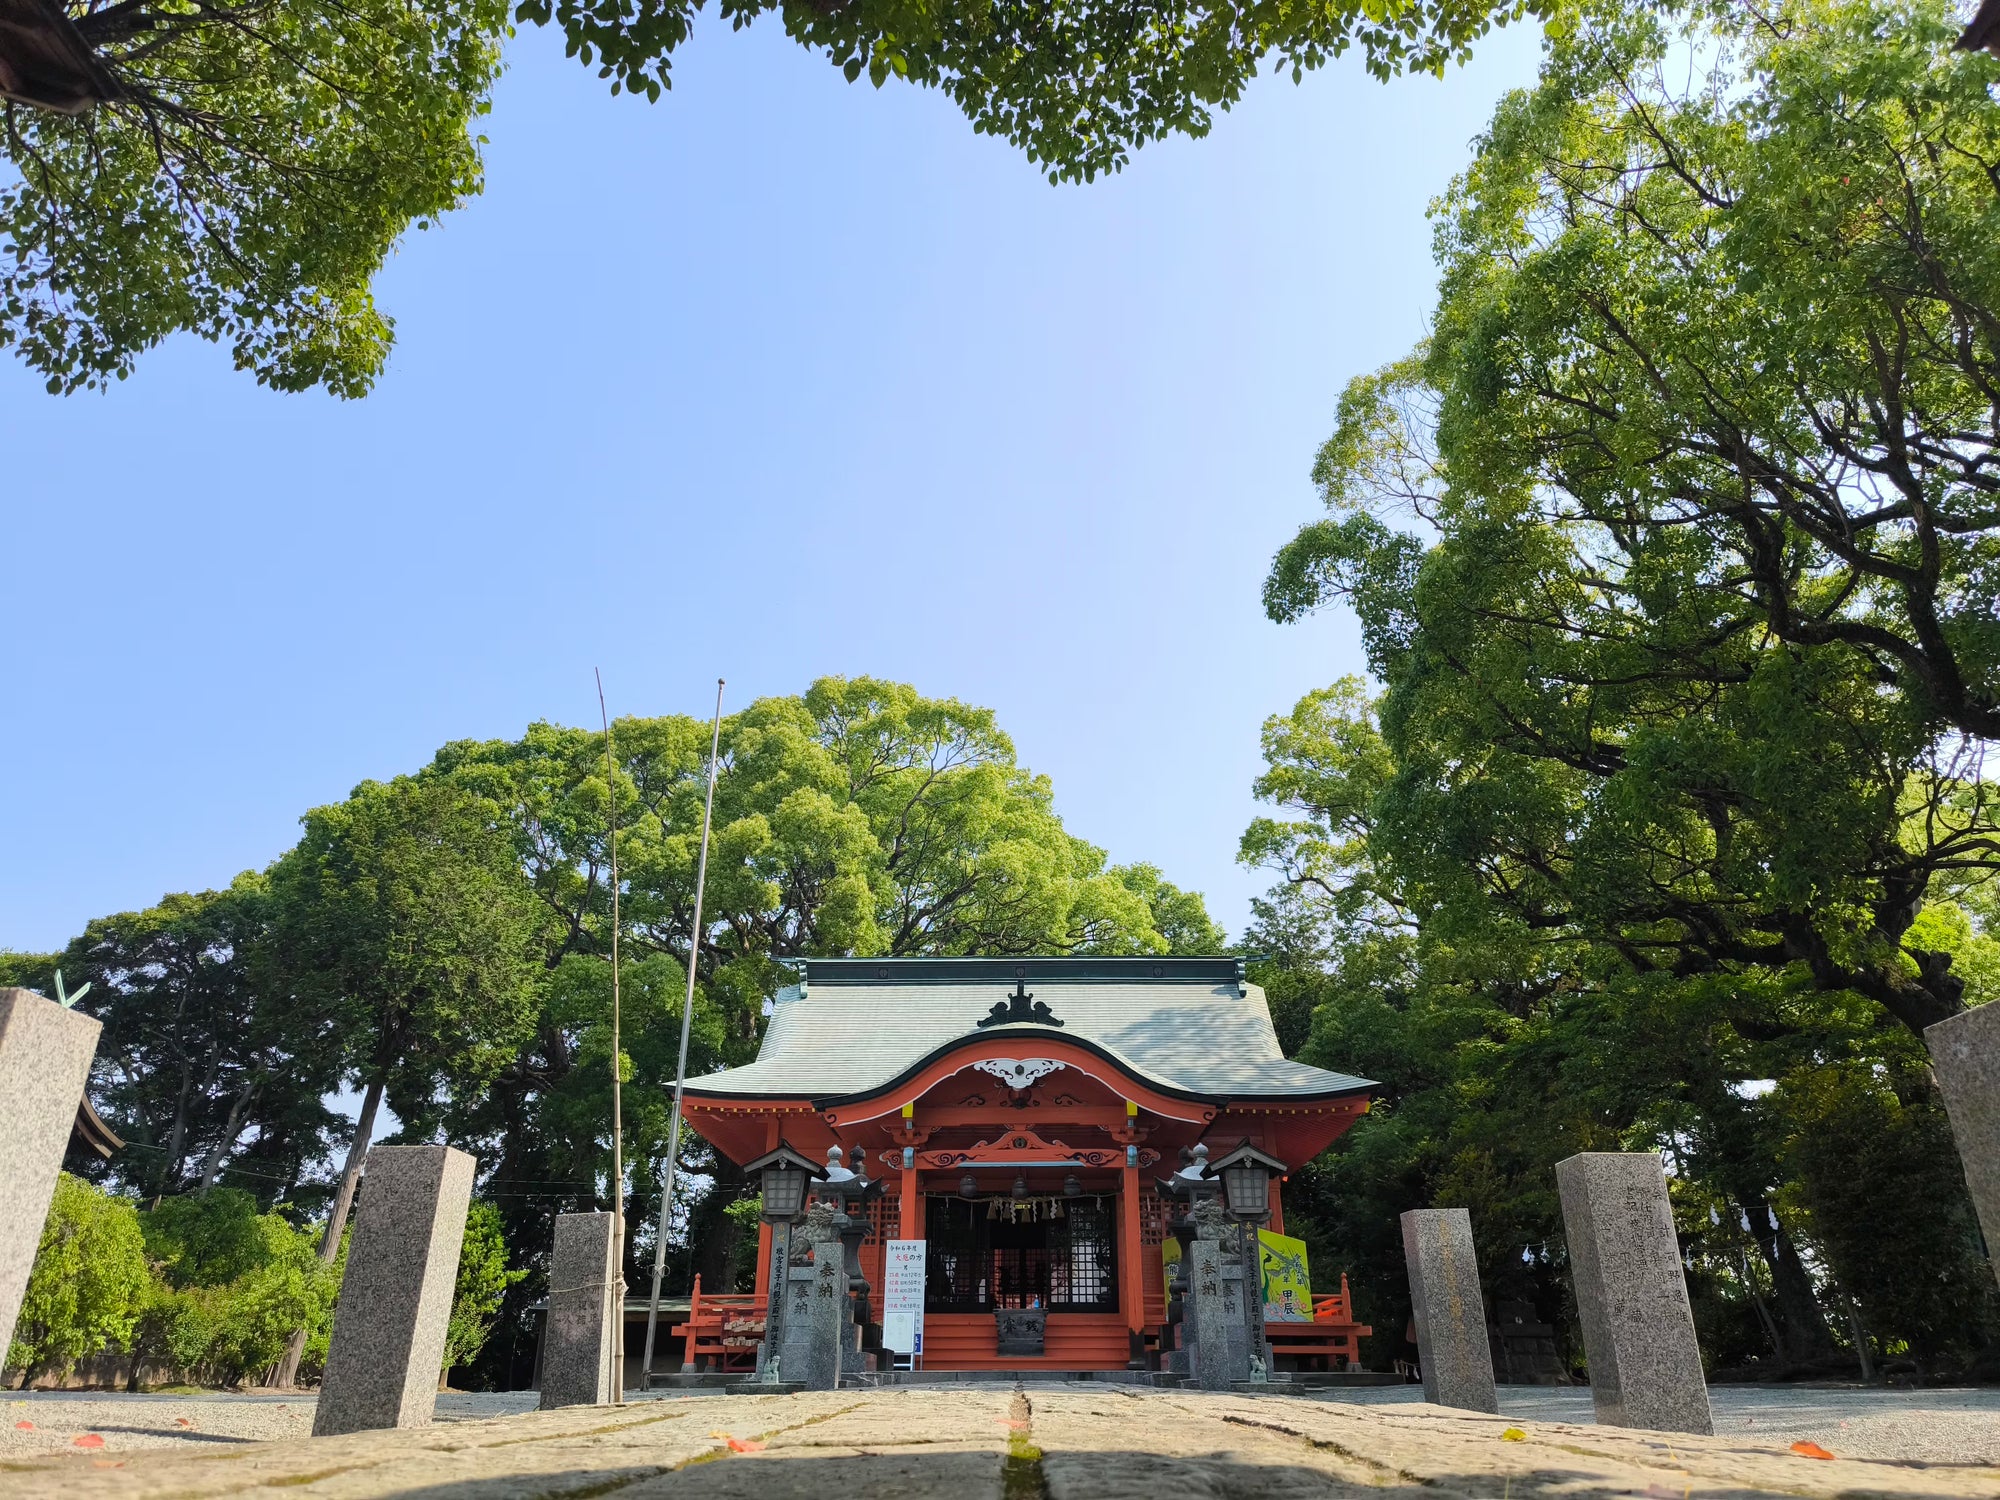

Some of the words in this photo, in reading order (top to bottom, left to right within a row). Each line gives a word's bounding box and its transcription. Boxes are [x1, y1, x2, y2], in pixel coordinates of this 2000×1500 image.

[817, 1261, 835, 1299] 奉納
[1200, 1258, 1218, 1297] 奉納
[794, 1284, 810, 1316] 奉納
[1222, 1283, 1236, 1315] 奉納
[1282, 1289, 1295, 1315] 甲辰
